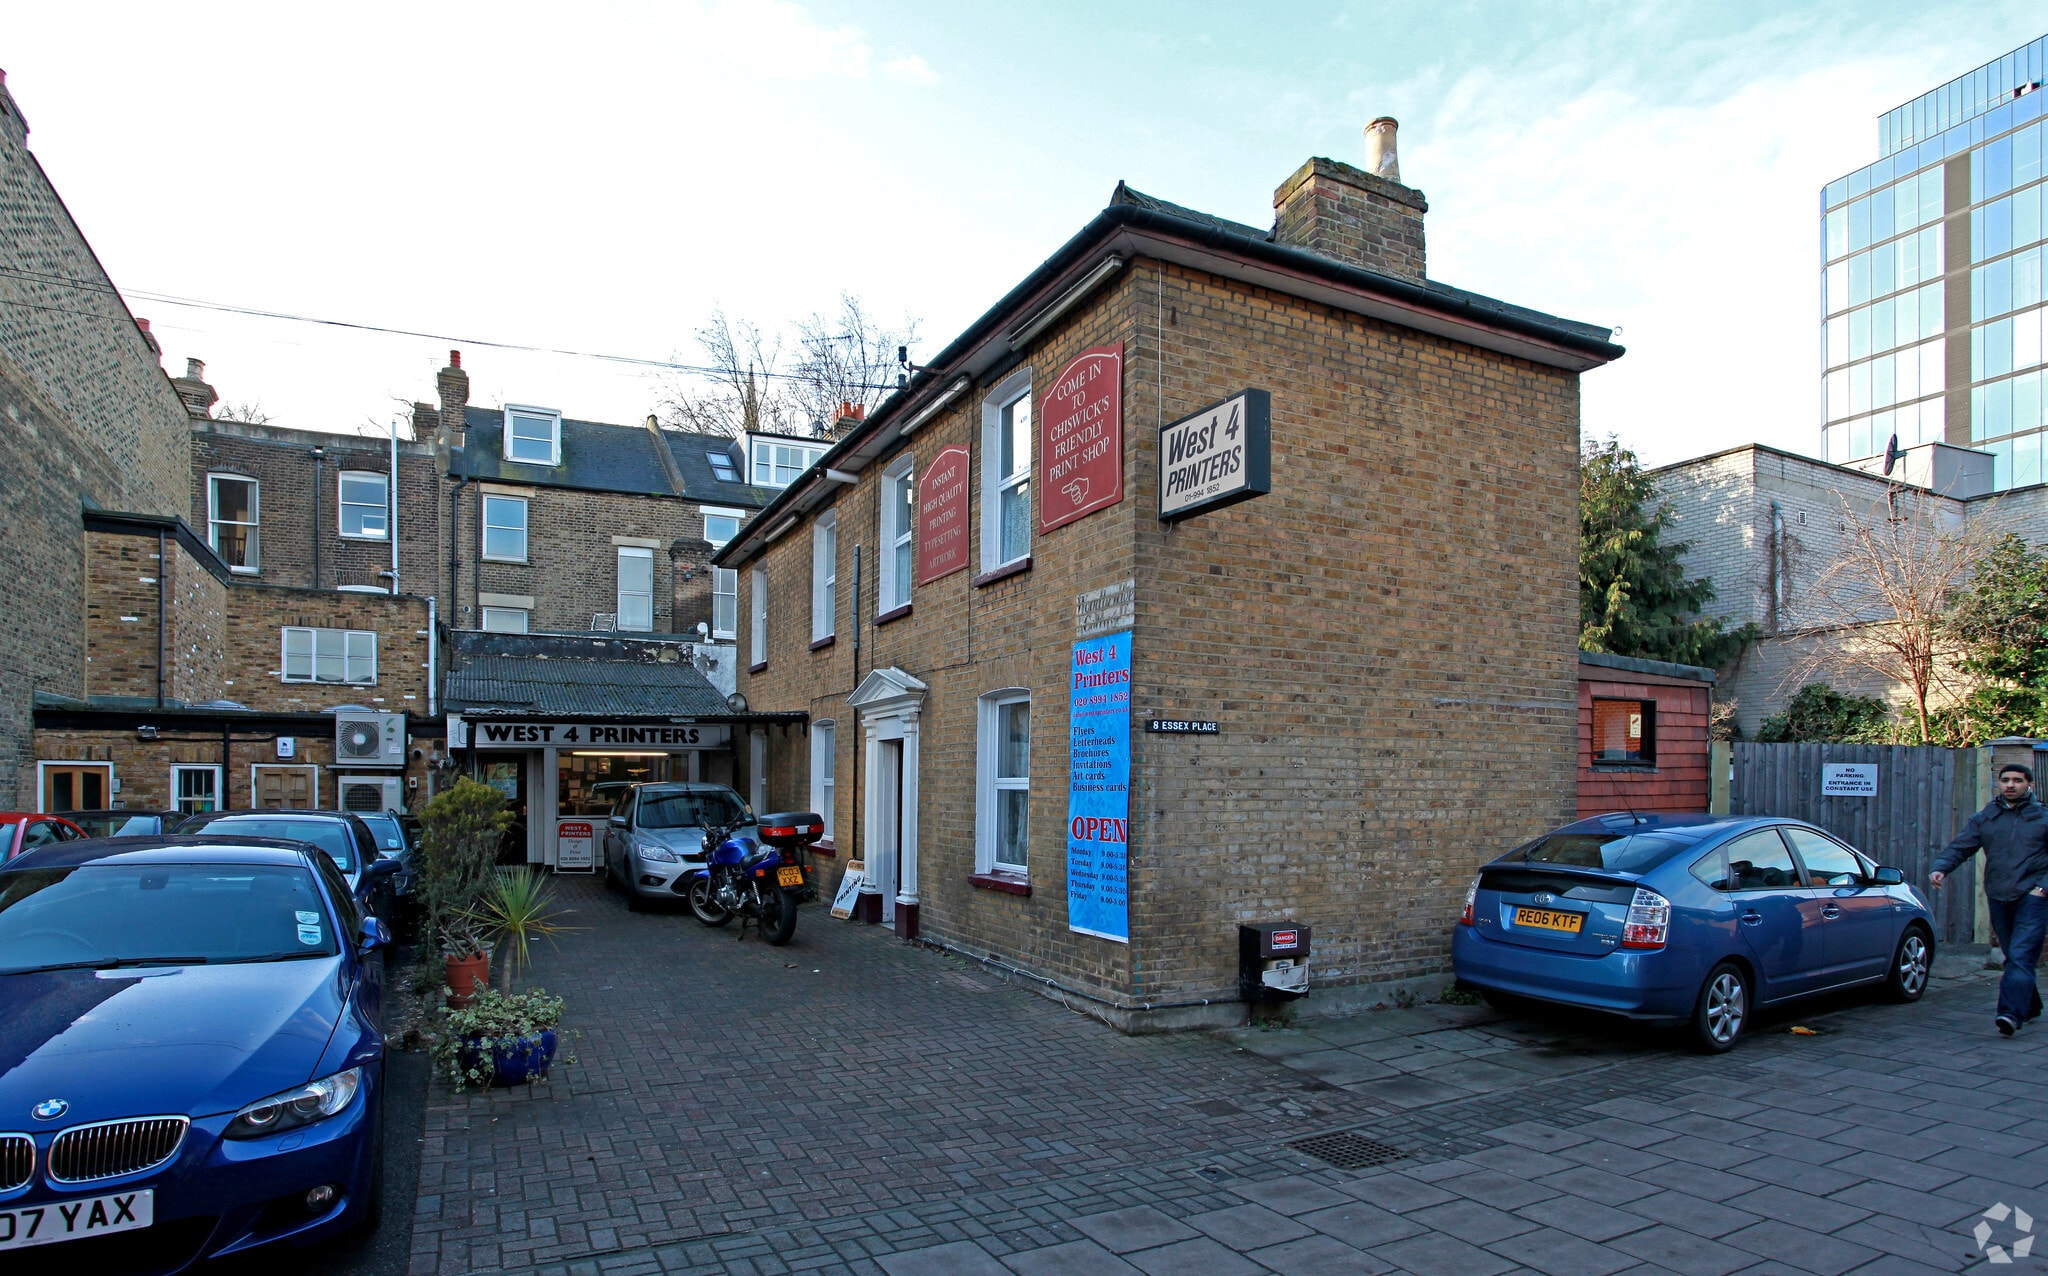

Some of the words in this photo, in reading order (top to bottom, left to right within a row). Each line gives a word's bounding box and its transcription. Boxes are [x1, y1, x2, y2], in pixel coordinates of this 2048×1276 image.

[1057, 370, 1086, 400] COME
[1089, 360, 1102, 381] IN
[1072, 391, 1086, 410] TO
[1050, 395, 1110, 442] CHISWICK'S
[1055, 419, 1104, 460] FRIENDLY
[1168, 415, 1218, 466] West
[1225, 403, 1240, 440] 4
[1049, 453, 1079, 483] PRINT
[1082, 436, 1110, 464] SHOP
[932, 466, 956, 490] INSTANT
[1166, 444, 1242, 498] PRINTERS
[923, 496, 938, 514] HIGH
[938, 481, 963, 506] QUALITY
[1185, 489, 1204, 502] 01-994
[1206, 483, 1220, 495] 1852
[929, 507, 957, 531] PRINTING
[924, 525, 961, 552] TYPESETTING
[928, 548, 957, 569] ARTWORK
[1075, 646, 1104, 667] West
[1108, 644, 1117, 660] 4
[1074, 668, 1130, 690] Printers
[1074, 696, 1088, 707] 020
[1089, 694, 1107, 705] 8994
[1110, 691, 1129, 703] 1852
[484, 725, 554, 742] WEST
[563, 726, 579, 742] 4
[589, 727, 699, 744] PRINTERS
[1073, 726, 1095, 736] Flyers
[1153, 721, 1159, 729] 8
[1162, 721, 1189, 730] ESSEX
[1192, 722, 1217, 731] PLACE
[1073, 736, 1116, 747] Letterheads
[1073, 749, 1110, 758] Brochures
[1073, 760, 1112, 769] Invitations
[1072, 771, 1083, 780] Art
[1085, 771, 1105, 781] cards
[1072, 782, 1104, 792] Business
[1106, 782, 1127, 792] cards
[1071, 816, 1127, 843] OPEN
[1071, 847, 1091, 857] Monday
[1071, 858, 1092, 868] Tuesday
[782, 876, 799, 884] XXZ
[1070, 869, 1099, 880] Wednesday
[836, 875, 861, 905] PRINTING
[1070, 880, 1095, 891] Thursday
[1070, 890, 1087, 901] Friday
[1518, 910, 1550, 925] RE06
[1552, 914, 1578, 928] KTF
[59, 1194, 136, 1232] YAX
